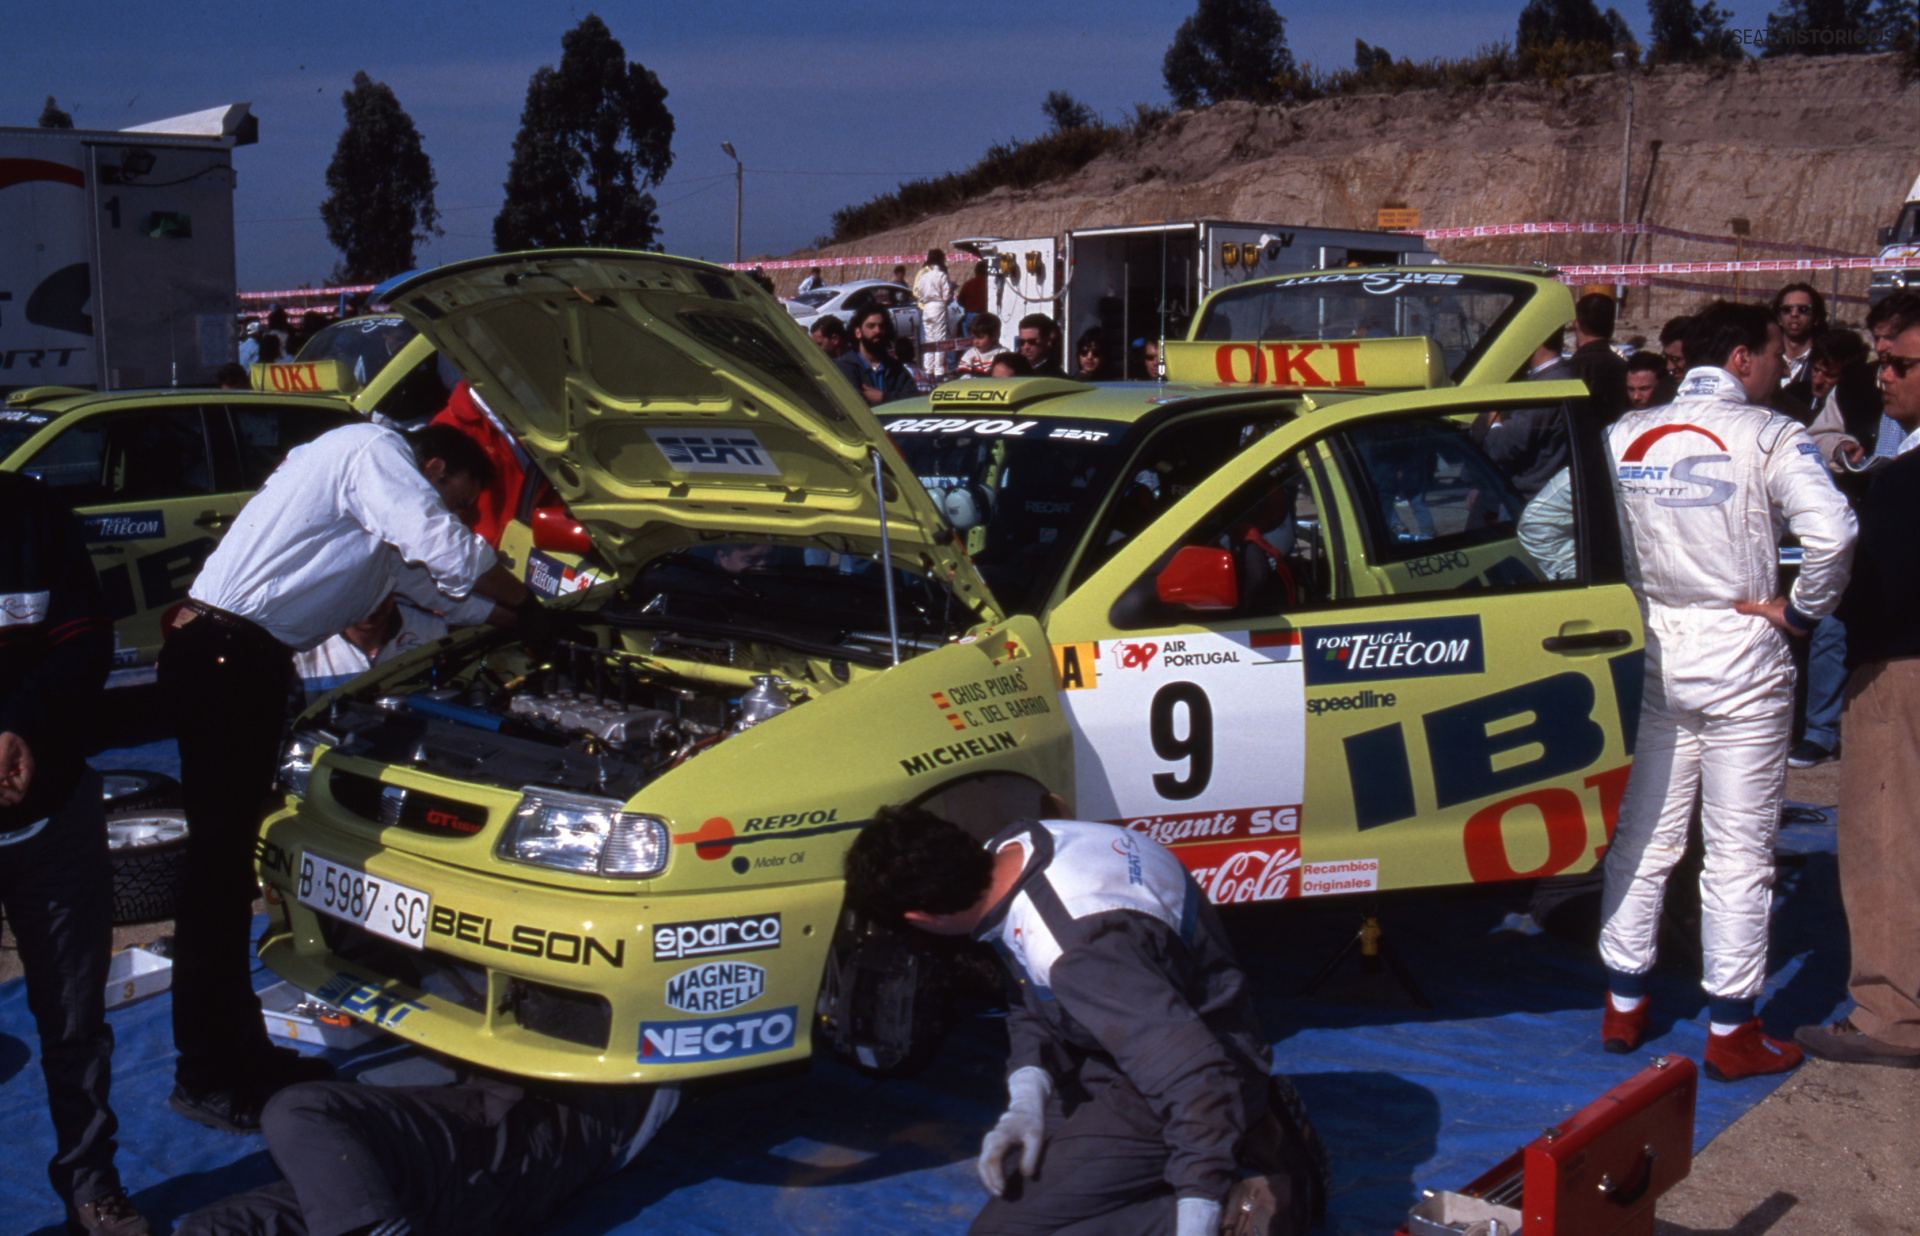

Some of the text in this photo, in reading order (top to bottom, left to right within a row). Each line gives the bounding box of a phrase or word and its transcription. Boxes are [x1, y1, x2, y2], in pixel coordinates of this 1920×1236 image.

[269, 363, 322, 392] OKI
[1214, 342, 1366, 388] OKI
[931, 390, 1008, 402] BELSON
[884, 418, 1038, 436] REPSOL
[1048, 428, 1109, 442] SEAT
[656, 436, 764, 466] SEAT
[1618, 466, 1668, 480] SEAT
[100, 517, 159, 537] TELECOM
[1404, 551, 1470, 578] RECARO
[1163, 641, 1187, 653] AIR
[1164, 652, 1240, 668] PORTUGAL
[1347, 635, 1470, 669] TELECOM
[1063, 646, 1084, 689] A
[949, 682, 988, 706] CHUS
[1306, 690, 1396, 716] speedline
[963, 695, 1051, 728] C. DEL BARRIO
[1150, 680, 1213, 801] 9
[900, 731, 1018, 777] MICHELIN
[743, 809, 839, 832] REPSOL
[1126, 812, 1237, 844] Gigante
[1249, 808, 1297, 834] SG
[754, 851, 806, 869] Motor Oil
[1303, 861, 1377, 876] Recambios
[1303, 879, 1371, 893] Originales
[431, 905, 625, 968] BELSON
[655, 917, 781, 958] sparco
